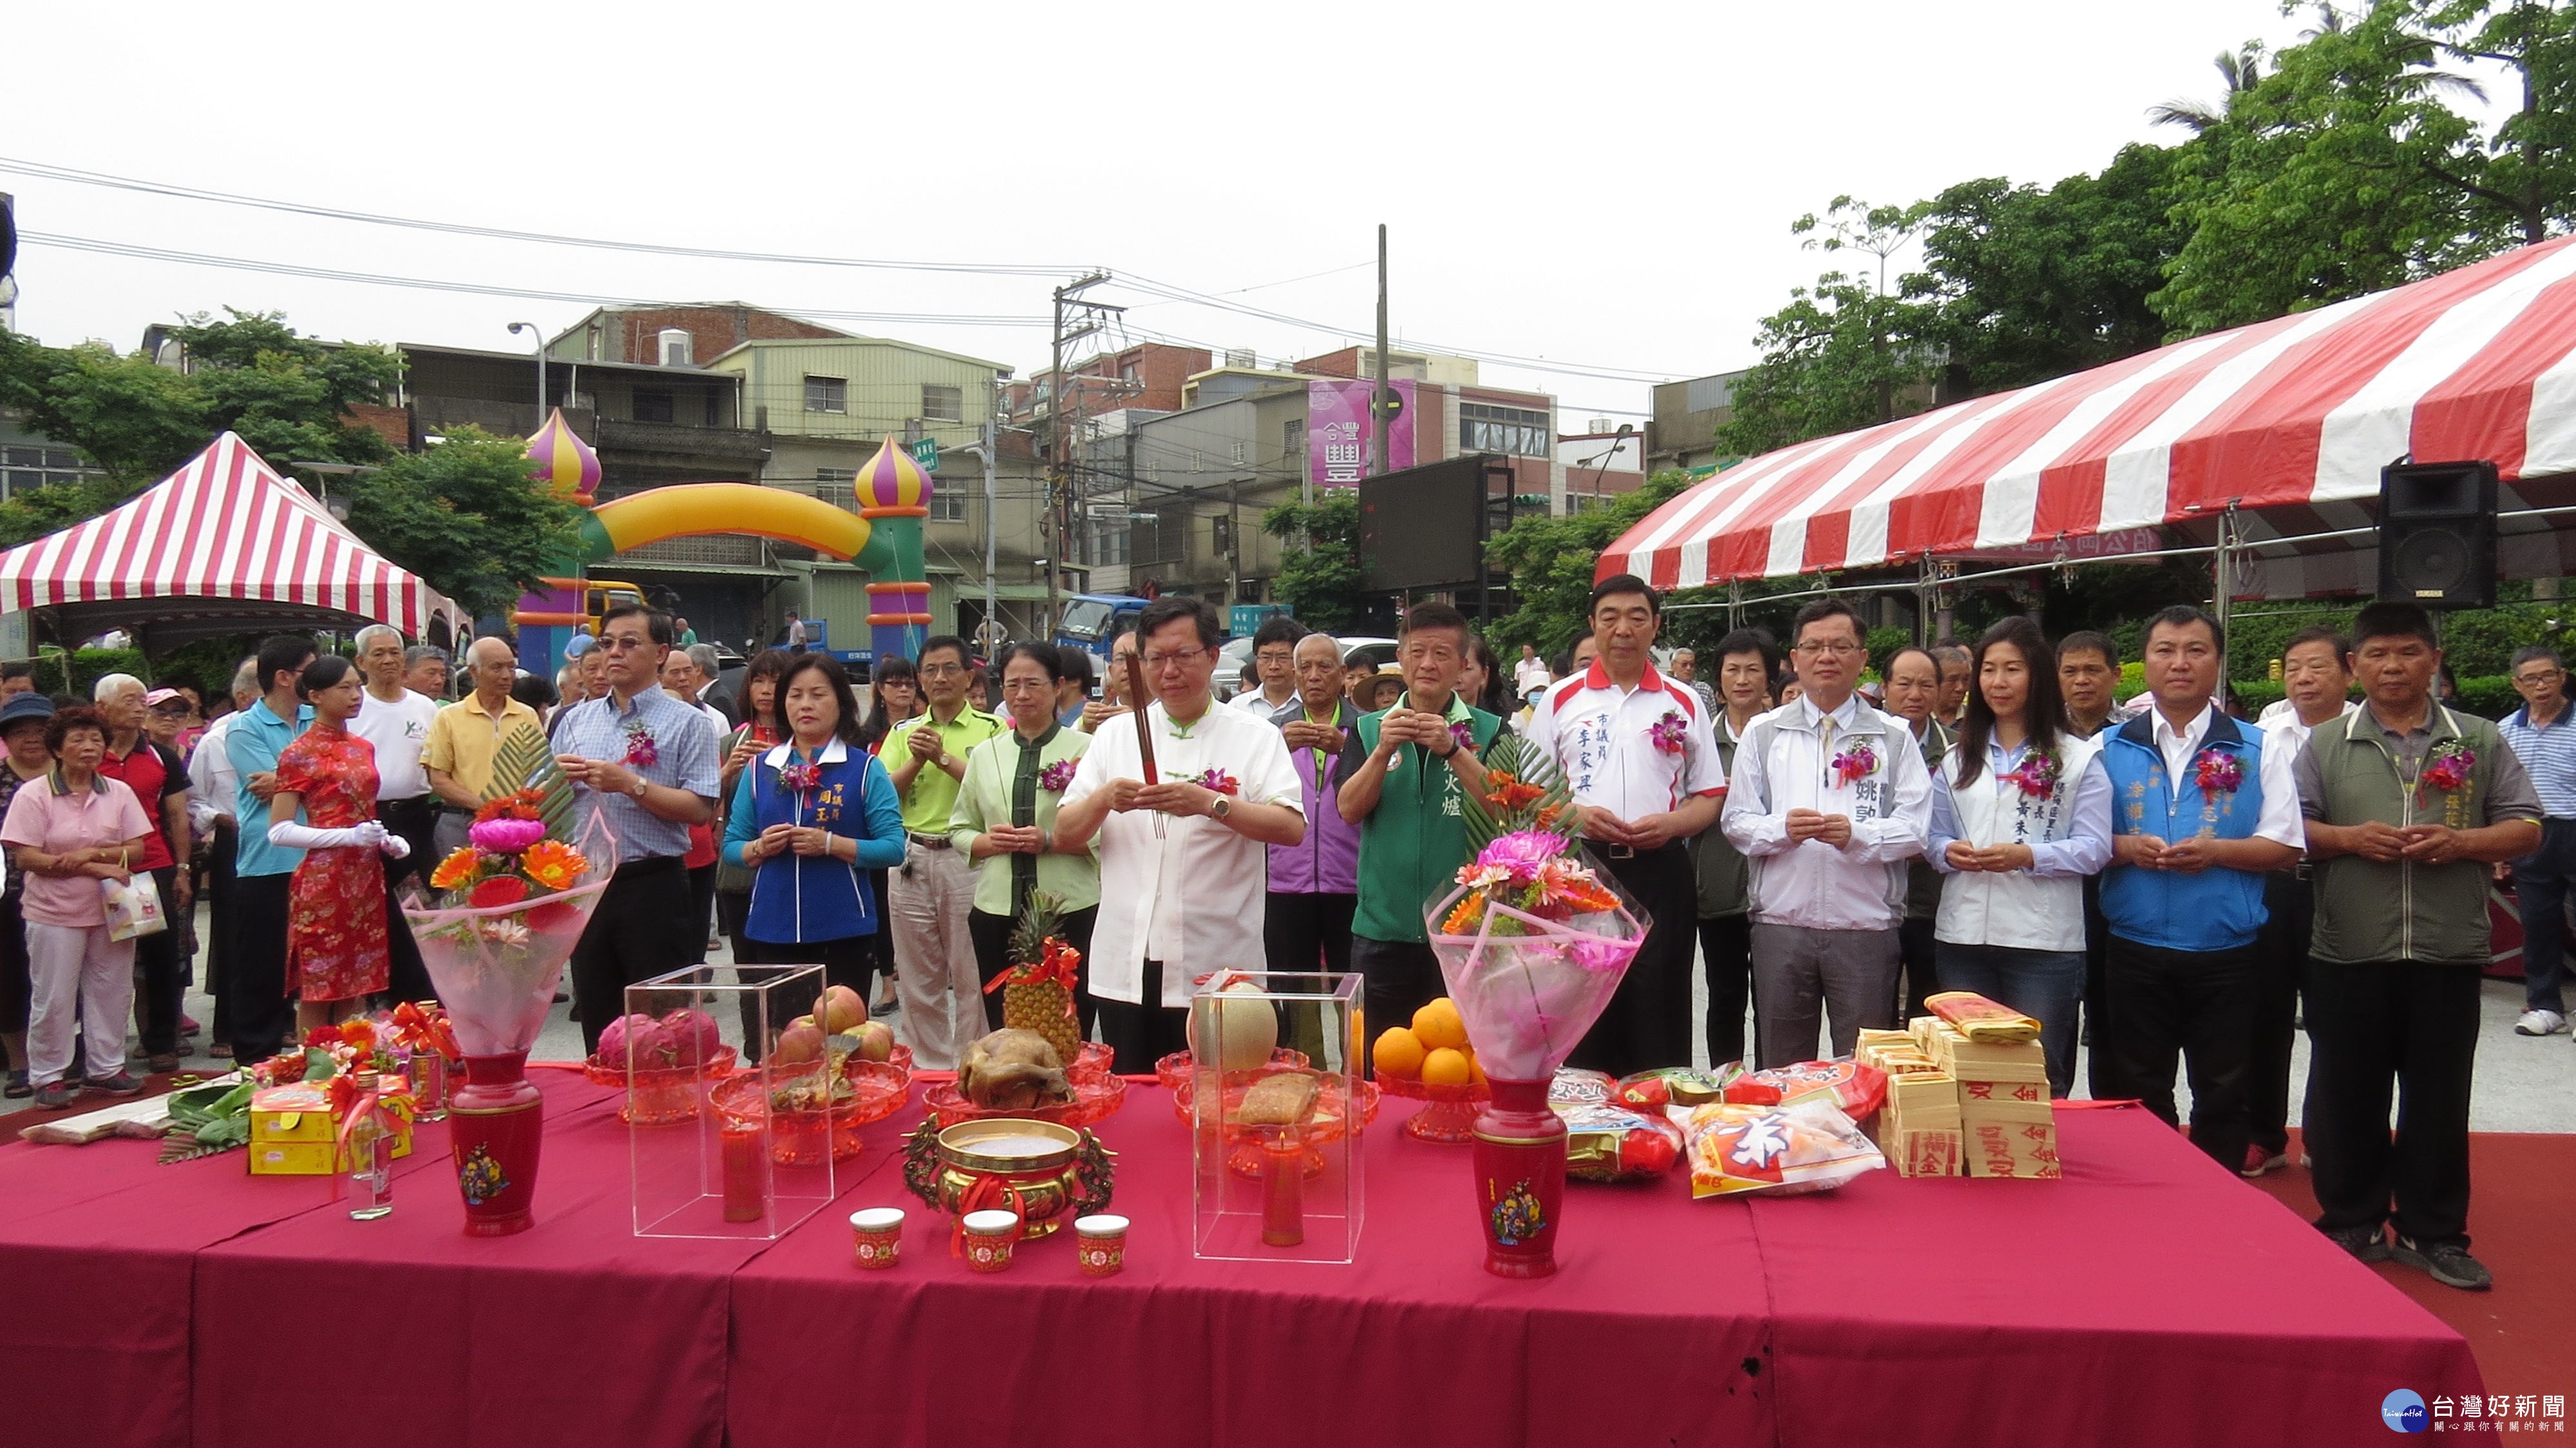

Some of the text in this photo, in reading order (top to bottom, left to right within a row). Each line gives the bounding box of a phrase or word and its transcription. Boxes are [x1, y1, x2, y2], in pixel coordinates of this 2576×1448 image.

[1324, 444, 1361, 497] 豐
[1577, 729, 1593, 792] 李家興
[1595, 713, 1609, 760] 市議員
[816, 790, 832, 830] 周玉
[2043, 781, 2065, 844] 楊梅區里長
[1918, 1132, 1947, 1174] 福金
